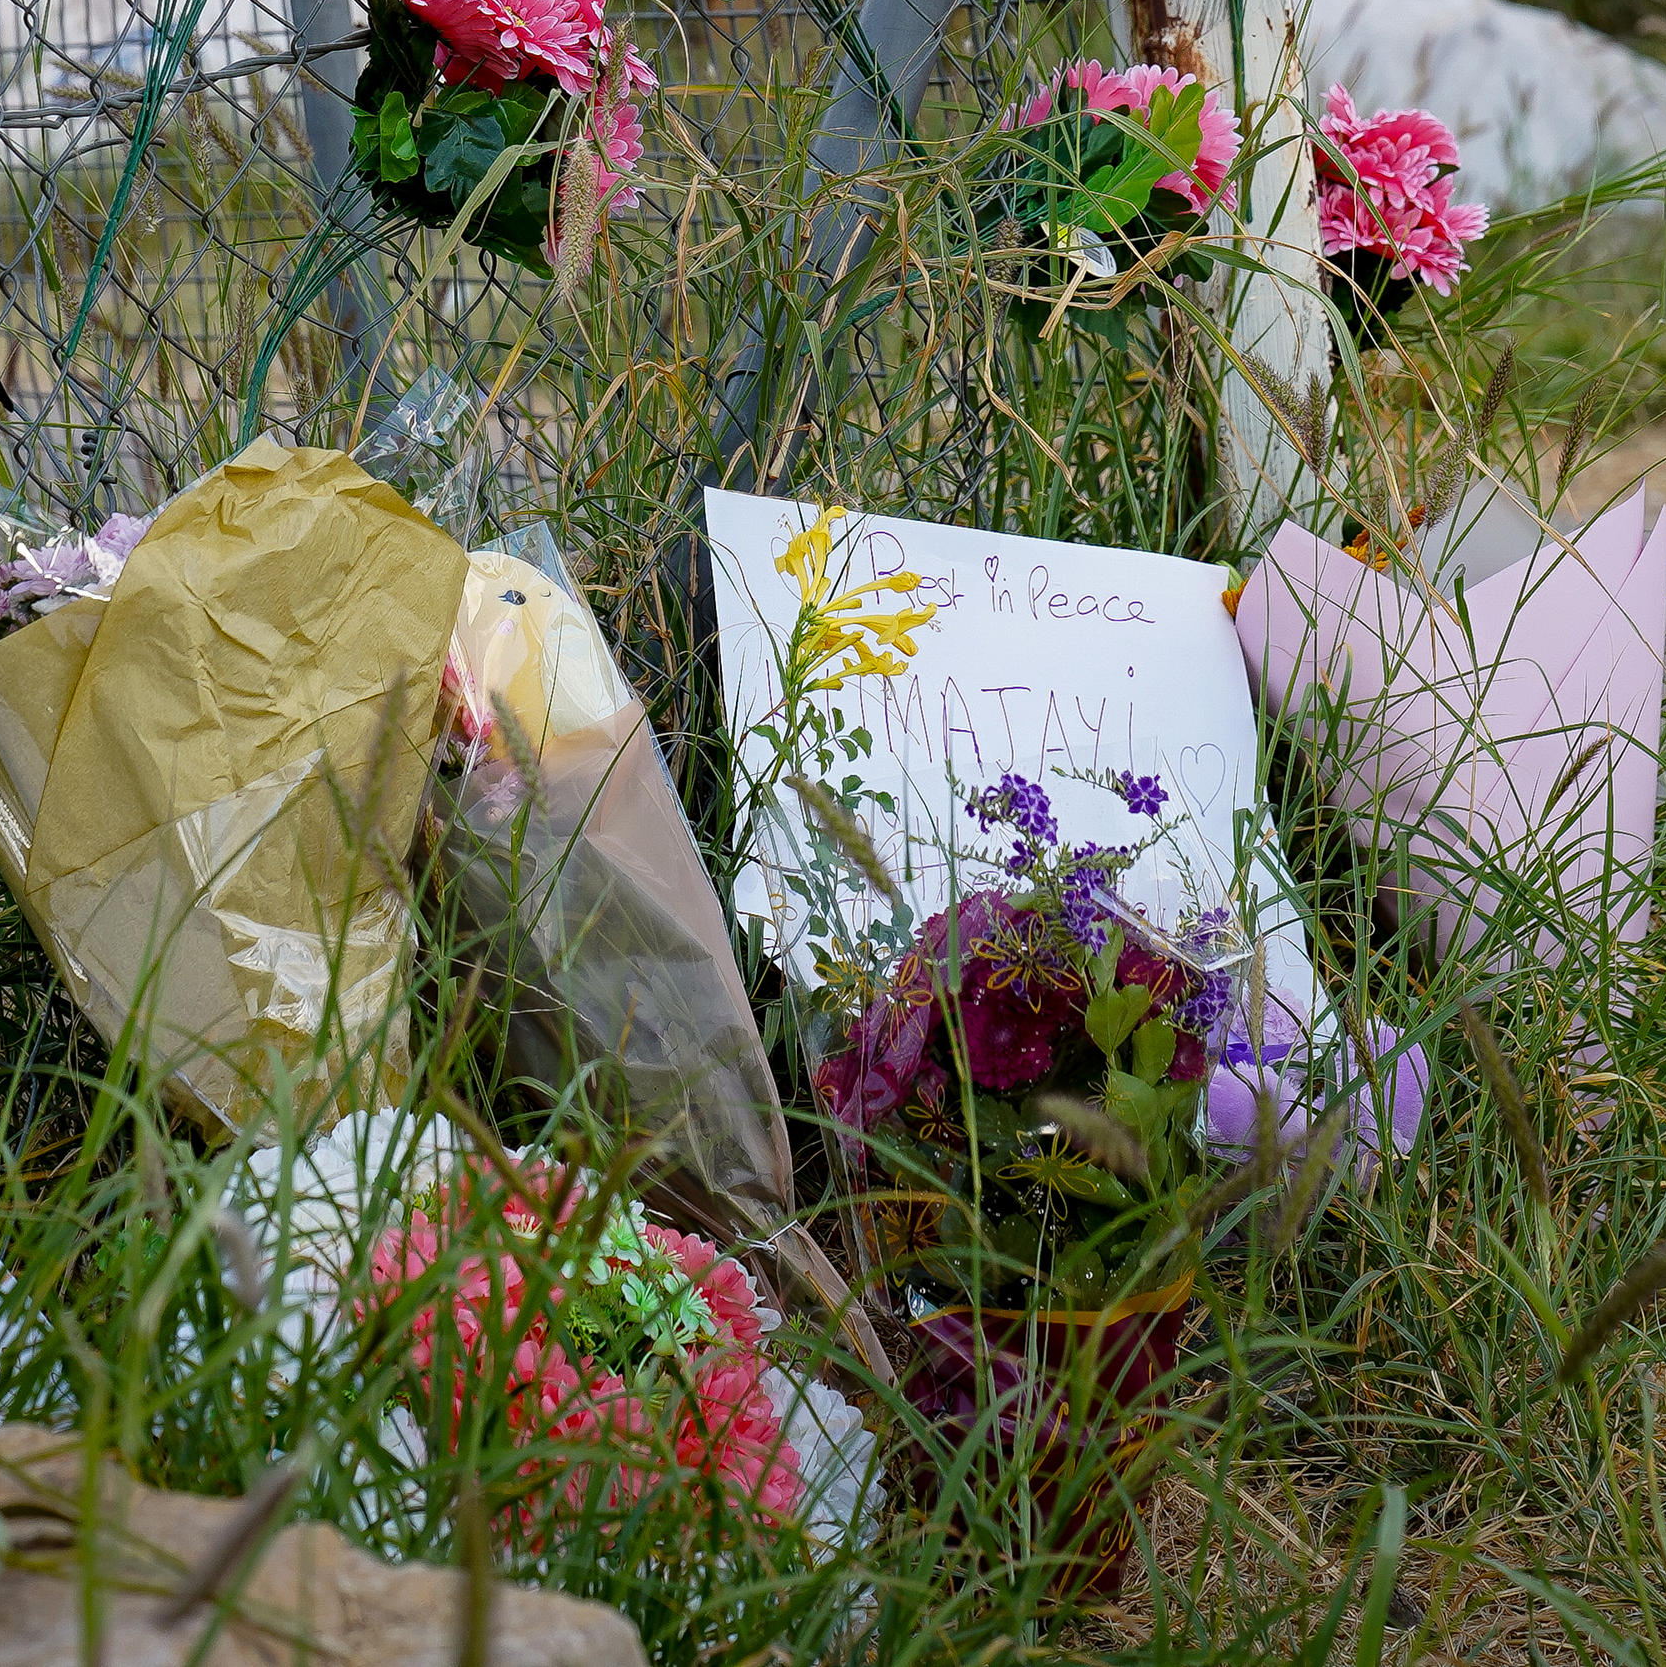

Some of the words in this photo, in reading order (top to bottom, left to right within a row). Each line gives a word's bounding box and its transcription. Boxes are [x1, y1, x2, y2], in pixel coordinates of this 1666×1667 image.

[863, 531, 965, 611] Rest
[992, 577, 1014, 614] in
[1028, 565, 1157, 624] Peace
